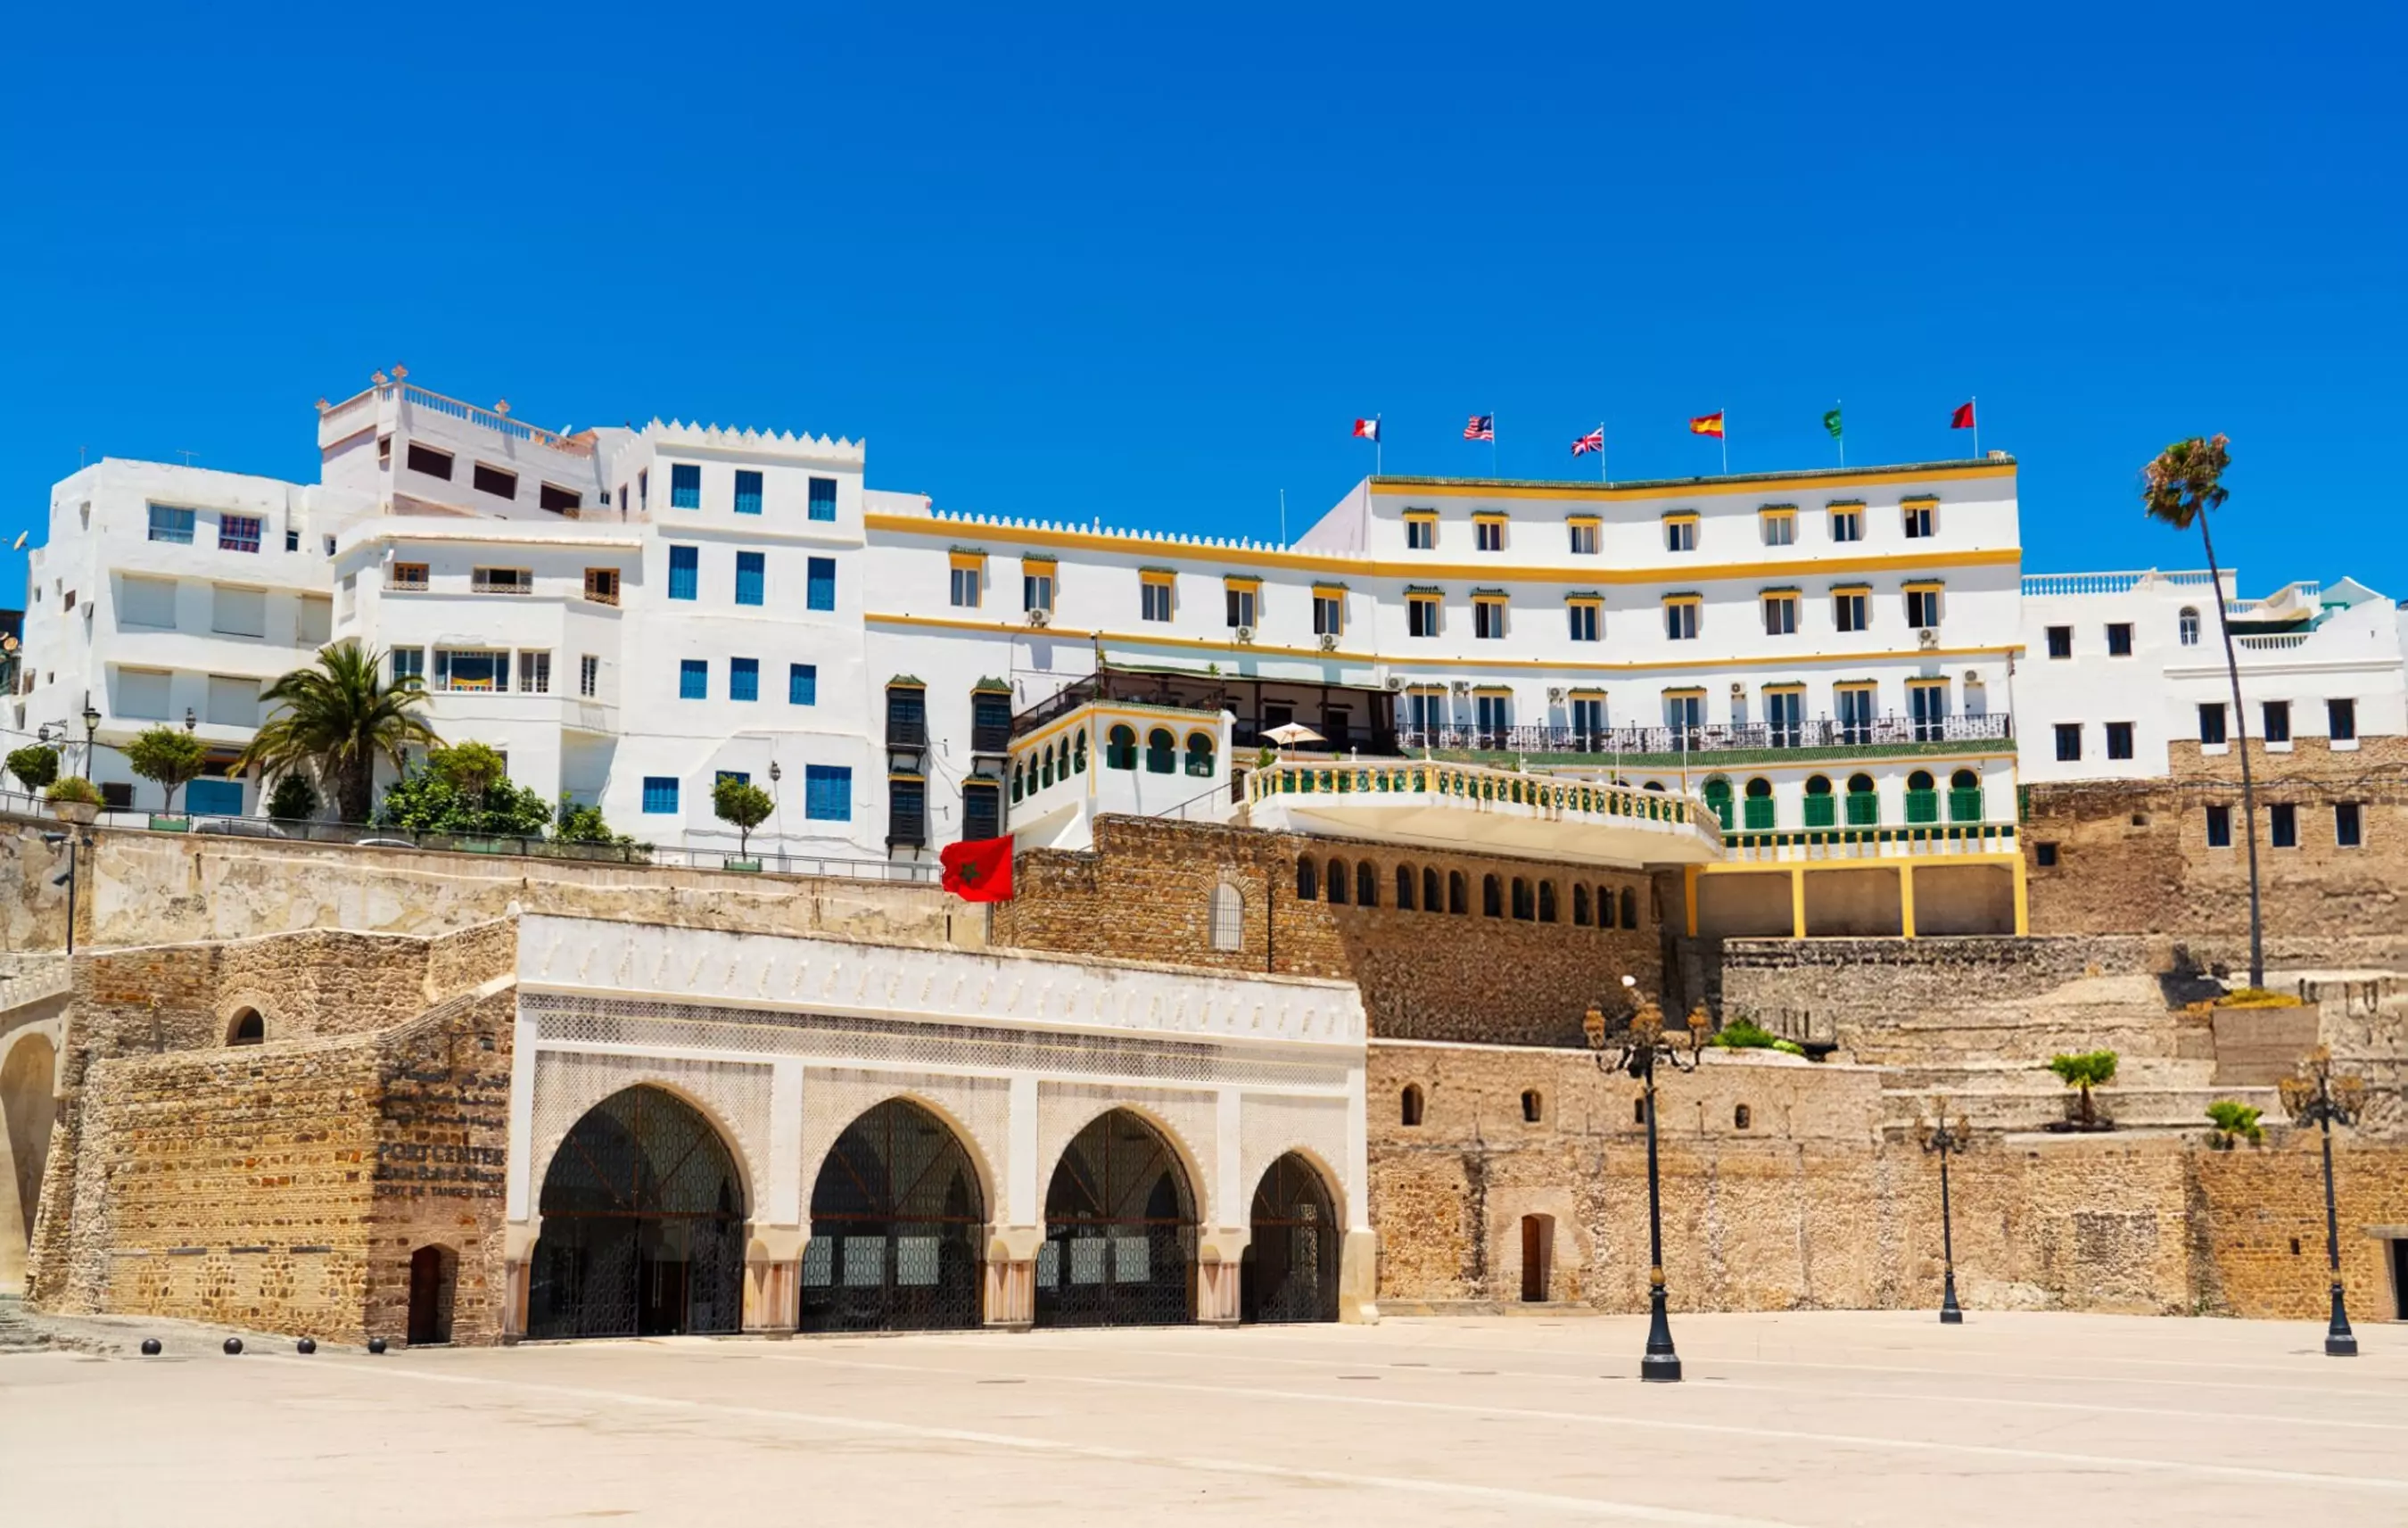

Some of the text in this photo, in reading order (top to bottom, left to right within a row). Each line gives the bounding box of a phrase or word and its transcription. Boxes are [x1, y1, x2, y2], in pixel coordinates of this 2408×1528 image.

[378, 1142, 505, 1166] PORT CENTER
[375, 1184, 406, 1196] PORT
[410, 1185, 425, 1196] DE
[432, 1186, 474, 1198] TANGER
